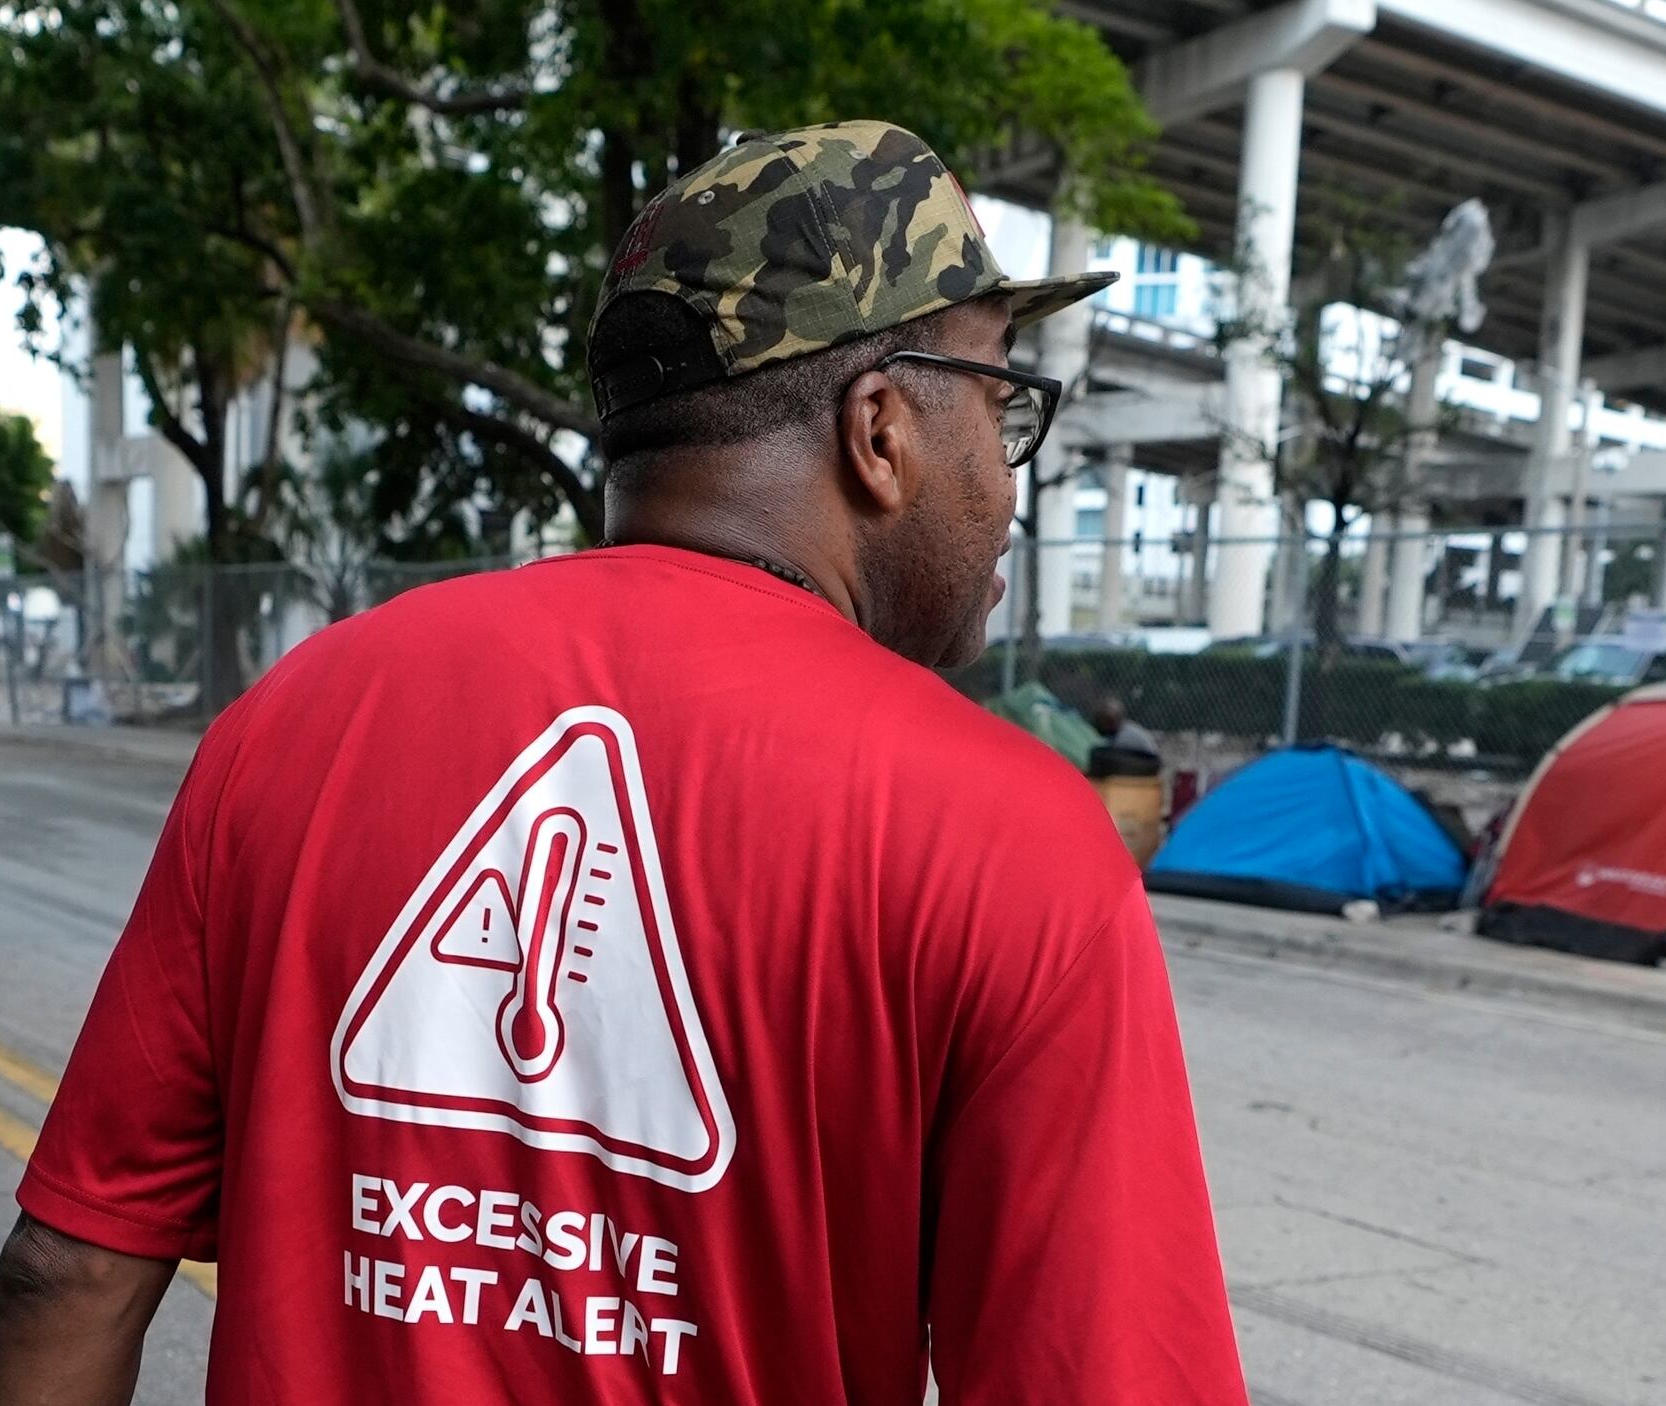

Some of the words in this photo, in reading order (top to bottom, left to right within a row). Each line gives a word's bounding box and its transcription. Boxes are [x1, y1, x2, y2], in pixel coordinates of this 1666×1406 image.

[352, 1173, 679, 1296] EXCESSIVE
[344, 1250, 498, 1324] HEAT
[504, 1277, 698, 1375] ALERT
